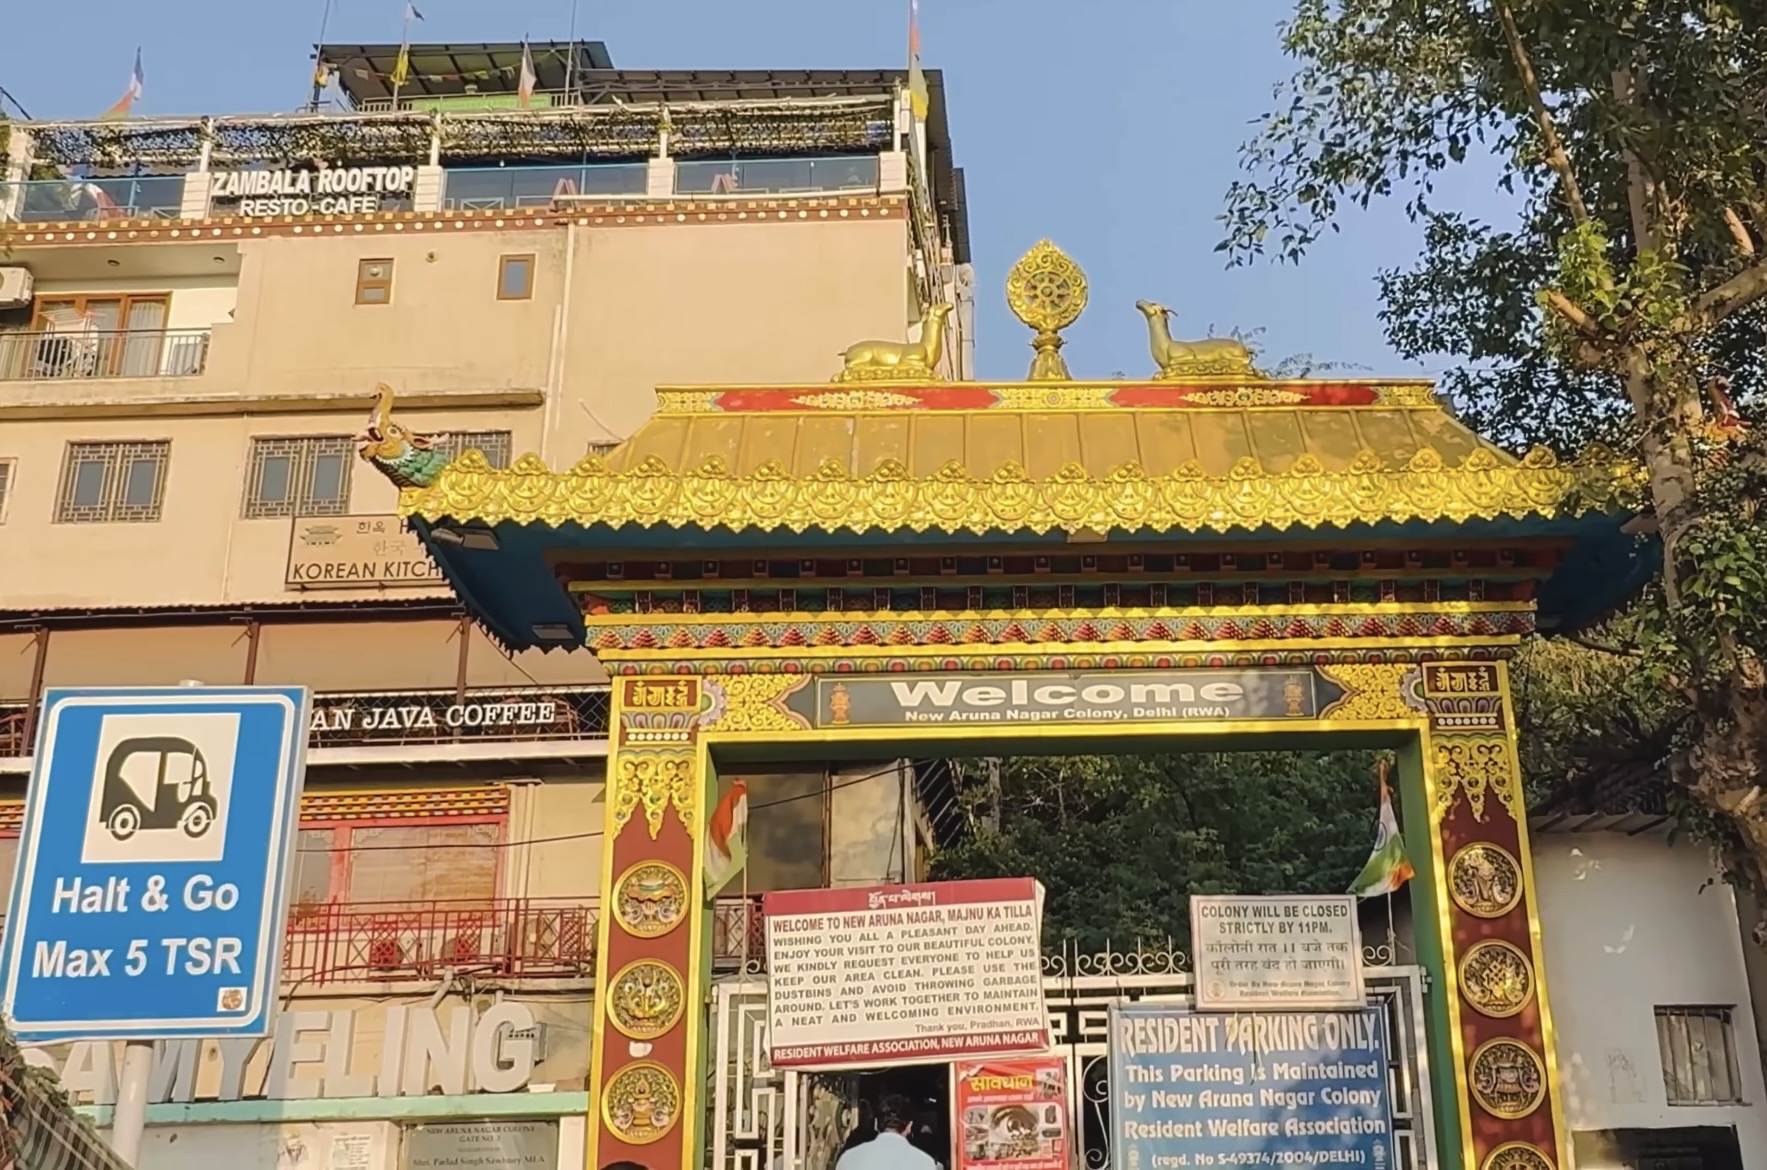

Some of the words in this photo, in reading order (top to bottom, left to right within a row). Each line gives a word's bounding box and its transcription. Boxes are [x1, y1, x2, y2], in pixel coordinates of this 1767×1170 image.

[211, 169, 310, 195] ZAMBALA
[318, 166, 414, 193] ROOFTOP
[293, 562, 376, 580] KOREAN
[891, 680, 1243, 707] Welcome
[362, 706, 437, 730] JAVA
[446, 702, 555, 727] COFFEE
[905, 710, 945, 722] New
[949, 709, 1000, 722] Aruna
[1006, 708, 1058, 722] Nagar
[1064, 706, 1128, 720] Colony,
[1133, 706, 1176, 718] Delhi
[1182, 706, 1230, 719] (RWA)
[52, 876, 130, 914] Halt
[141, 874, 169, 912] &
[183, 874, 239, 911] Go
[773, 919, 824, 933] WELCOME
[827, 917, 840, 930] TO
[843, 916, 866, 929] NEW
[869, 912, 904, 927] ARUNA
[906, 910, 946, 925] NAGAR,
[948, 907, 984, 921] MAJNU
[987, 906, 1001, 919] KA
[1004, 905, 1032, 918] TILLA
[1201, 905, 1249, 918] COLONY
[1252, 905, 1280, 918] WILL
[1284, 905, 1299, 917] BE
[1302, 905, 1348, 917] CLOSED
[774, 935, 822, 947] WISHING
[829, 934, 852, 944] YOU
[859, 932, 880, 942] ALL
[886, 931, 893, 940] A
[901, 926, 958, 939] PLEASANT
[965, 925, 986, 935] DAY
[993, 922, 1033, 933] AHEAD.
[1219, 922, 1275, 934] STRICTLY
[1279, 922, 1294, 934] BY
[1298, 922, 1333, 934] 11PM.
[32, 940, 113, 978] Max
[124, 939, 148, 977] 5
[161, 937, 242, 976] TSR
[774, 949, 810, 960] ENJOY
[814, 947, 844, 958] YOUR
[847, 945, 876, 956] VISIT
[880, 944, 894, 954] TO
[897, 941, 920, 952] OUR
[924, 938, 985, 951] BEAUTIFUL
[1205, 939, 1253, 953] कॉलोनी
[1258, 942, 1277, 953] रात
[1326, 942, 1349, 953] तक
[774, 964, 791, 973] WE
[797, 961, 837, 972] KINDLY
[844, 957, 895, 969] REQUEST
[901, 953, 959, 965] EVERYONE
[965, 951, 980, 961] TO
[986, 949, 1014, 960] HELP
[1020, 948, 1035, 958] US
[1211, 957, 1230, 976] पूरी
[1234, 960, 1258, 972] तरह
[775, 976, 804, 987] KEEP
[813, 974, 837, 985] OUR
[845, 972, 875, 983] AREA
[883, 968, 924, 980] CLEAN.
[932, 965, 975, 976] PLEASE
[983, 963, 1006, 974] USE
[1014, 961, 1037, 971] THE
[775, 988, 832, 1000] DUSTBINS
[840, 986, 864, 996] AND
[872, 983, 906, 995] AVOID
[915, 978, 975, 991] THROWING
[983, 975, 1037, 987] GARBAGE
[775, 1002, 825, 1014] AROUND.
[829, 1000, 859, 1011] LET'S
[863, 997, 897, 1008] WORK
[902, 993, 960, 1005] TOGETHER
[964, 991, 979, 1001] TO
[983, 988, 1038, 1000] MAINTAIN
[775, 1018, 783, 1027] A
[792, 1015, 823, 1026] NEAT
[831, 1013, 857, 1023] AND
[865, 1008, 939, 1021] WELCOMING
[948, 1002, 1039, 1016] ENVIRONMENT.
[915, 1023, 944, 1033] Thank
[947, 1021, 967, 1033] you,
[1016, 1017, 1039, 1027] RWA
[774, 1046, 823, 1060] RESIDENT
[823, 1043, 870, 1057] WELFARE
[871, 1039, 940, 1053] ASSOCIATION,
[941, 1036, 964, 1048] NEW
[965, 1034, 1002, 1047] ARUNA
[1002, 1032, 1039, 1044] NAGAR
[1120, 1017, 1219, 1057] RESIDENT
[1225, 1014, 1318, 1055] PARKING
[1323, 1013, 1379, 1054] ONLY.
[1125, 1064, 1163, 1083] This
[1170, 1064, 1244, 1085] Parking
[1272, 1061, 1379, 1080] Maintained
[1125, 1091, 1146, 1112] by
[1152, 1090, 1193, 1108] New
[1199, 1089, 1253, 1108] Aruna
[1260, 1088, 1315, 1109] Nagar
[1321, 1087, 1381, 1108] Colony
[1124, 1120, 1202, 1140] Resident
[1207, 1118, 1279, 1138] Welfare
[1285, 1116, 1386, 1137] Association
[1152, 1153, 1190, 1168] (regd.
[1195, 1152, 1214, 1166] No
